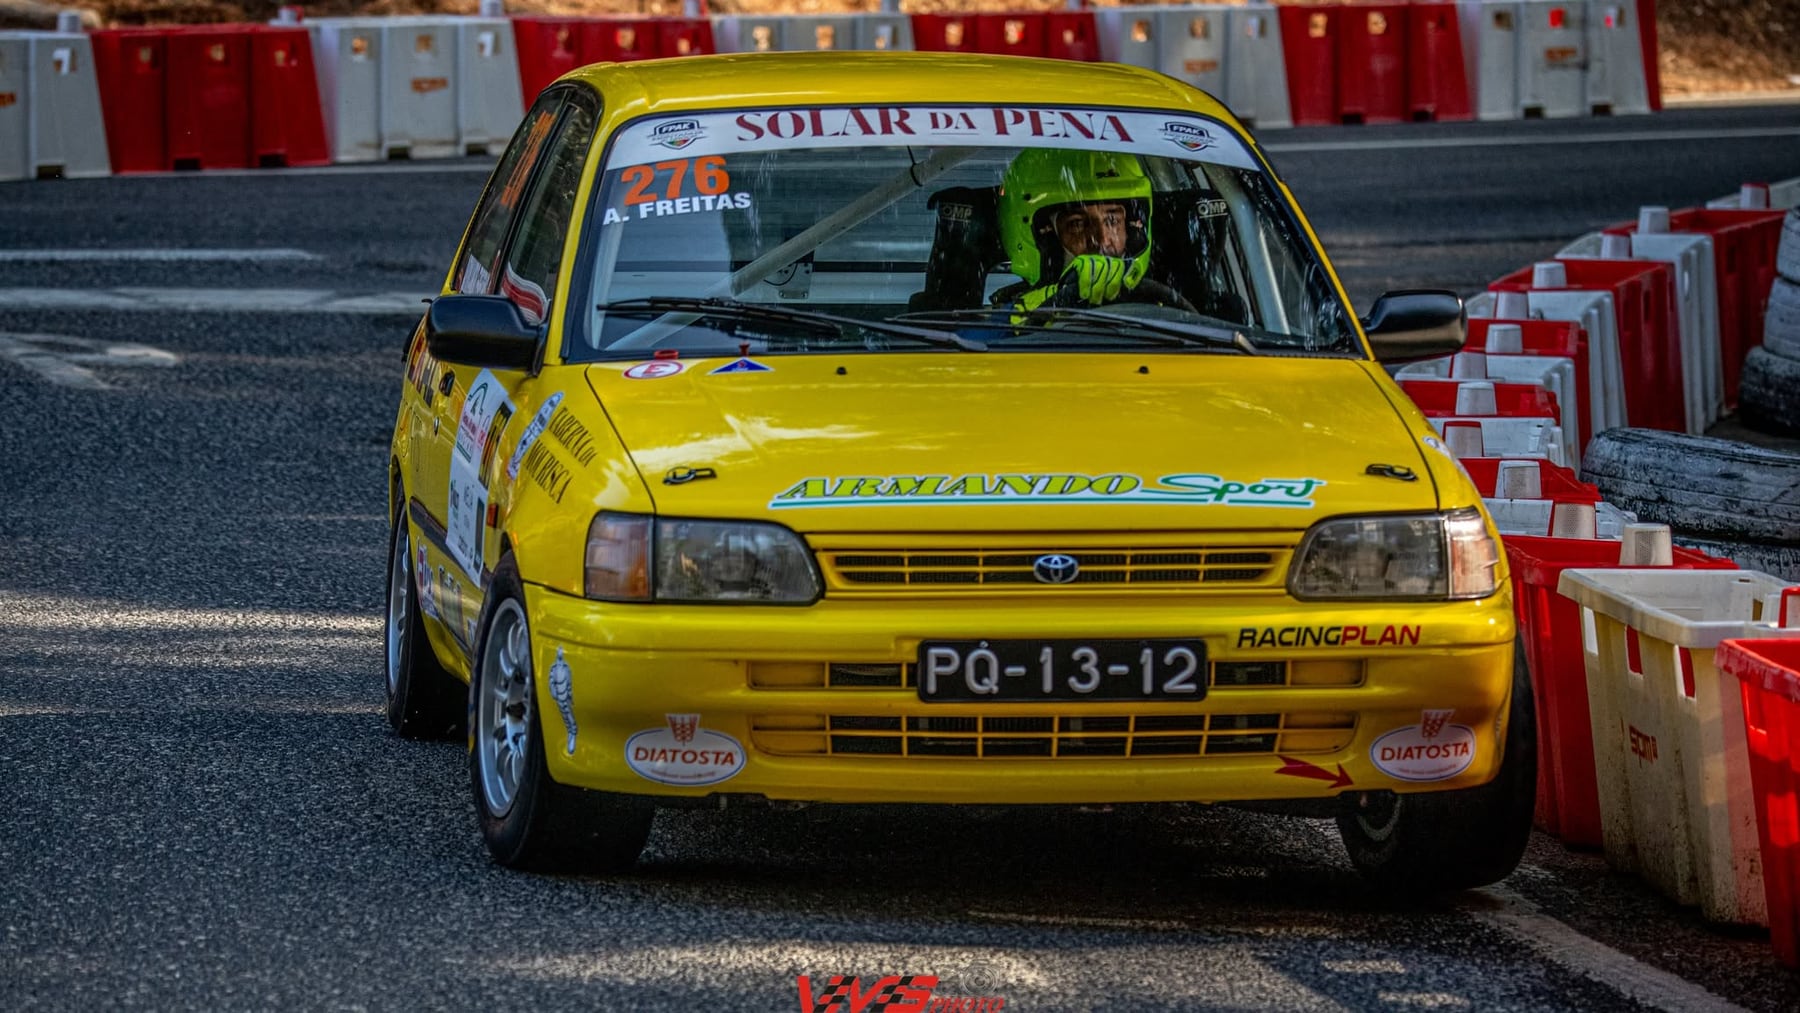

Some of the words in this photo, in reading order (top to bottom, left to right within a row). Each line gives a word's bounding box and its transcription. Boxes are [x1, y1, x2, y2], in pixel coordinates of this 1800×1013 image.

[736, 107, 915, 141] SOLAR
[929, 111, 977, 130] DA
[992, 108, 1134, 142] PENA
[621, 155, 730, 206] 276
[603, 208, 630, 226] A.
[639, 191, 751, 219] FREITAS
[1198, 201, 1228, 216] OMP
[777, 475, 1140, 498] ARMANDO
[1141, 474, 1325, 502] Sport
[1237, 625, 1422, 648] RACINGPLAN
[926, 647, 1199, 695] PQ-13-12
[634, 746, 735, 766] DIATOSTA
[1381, 741, 1470, 761] DIATOSTA
